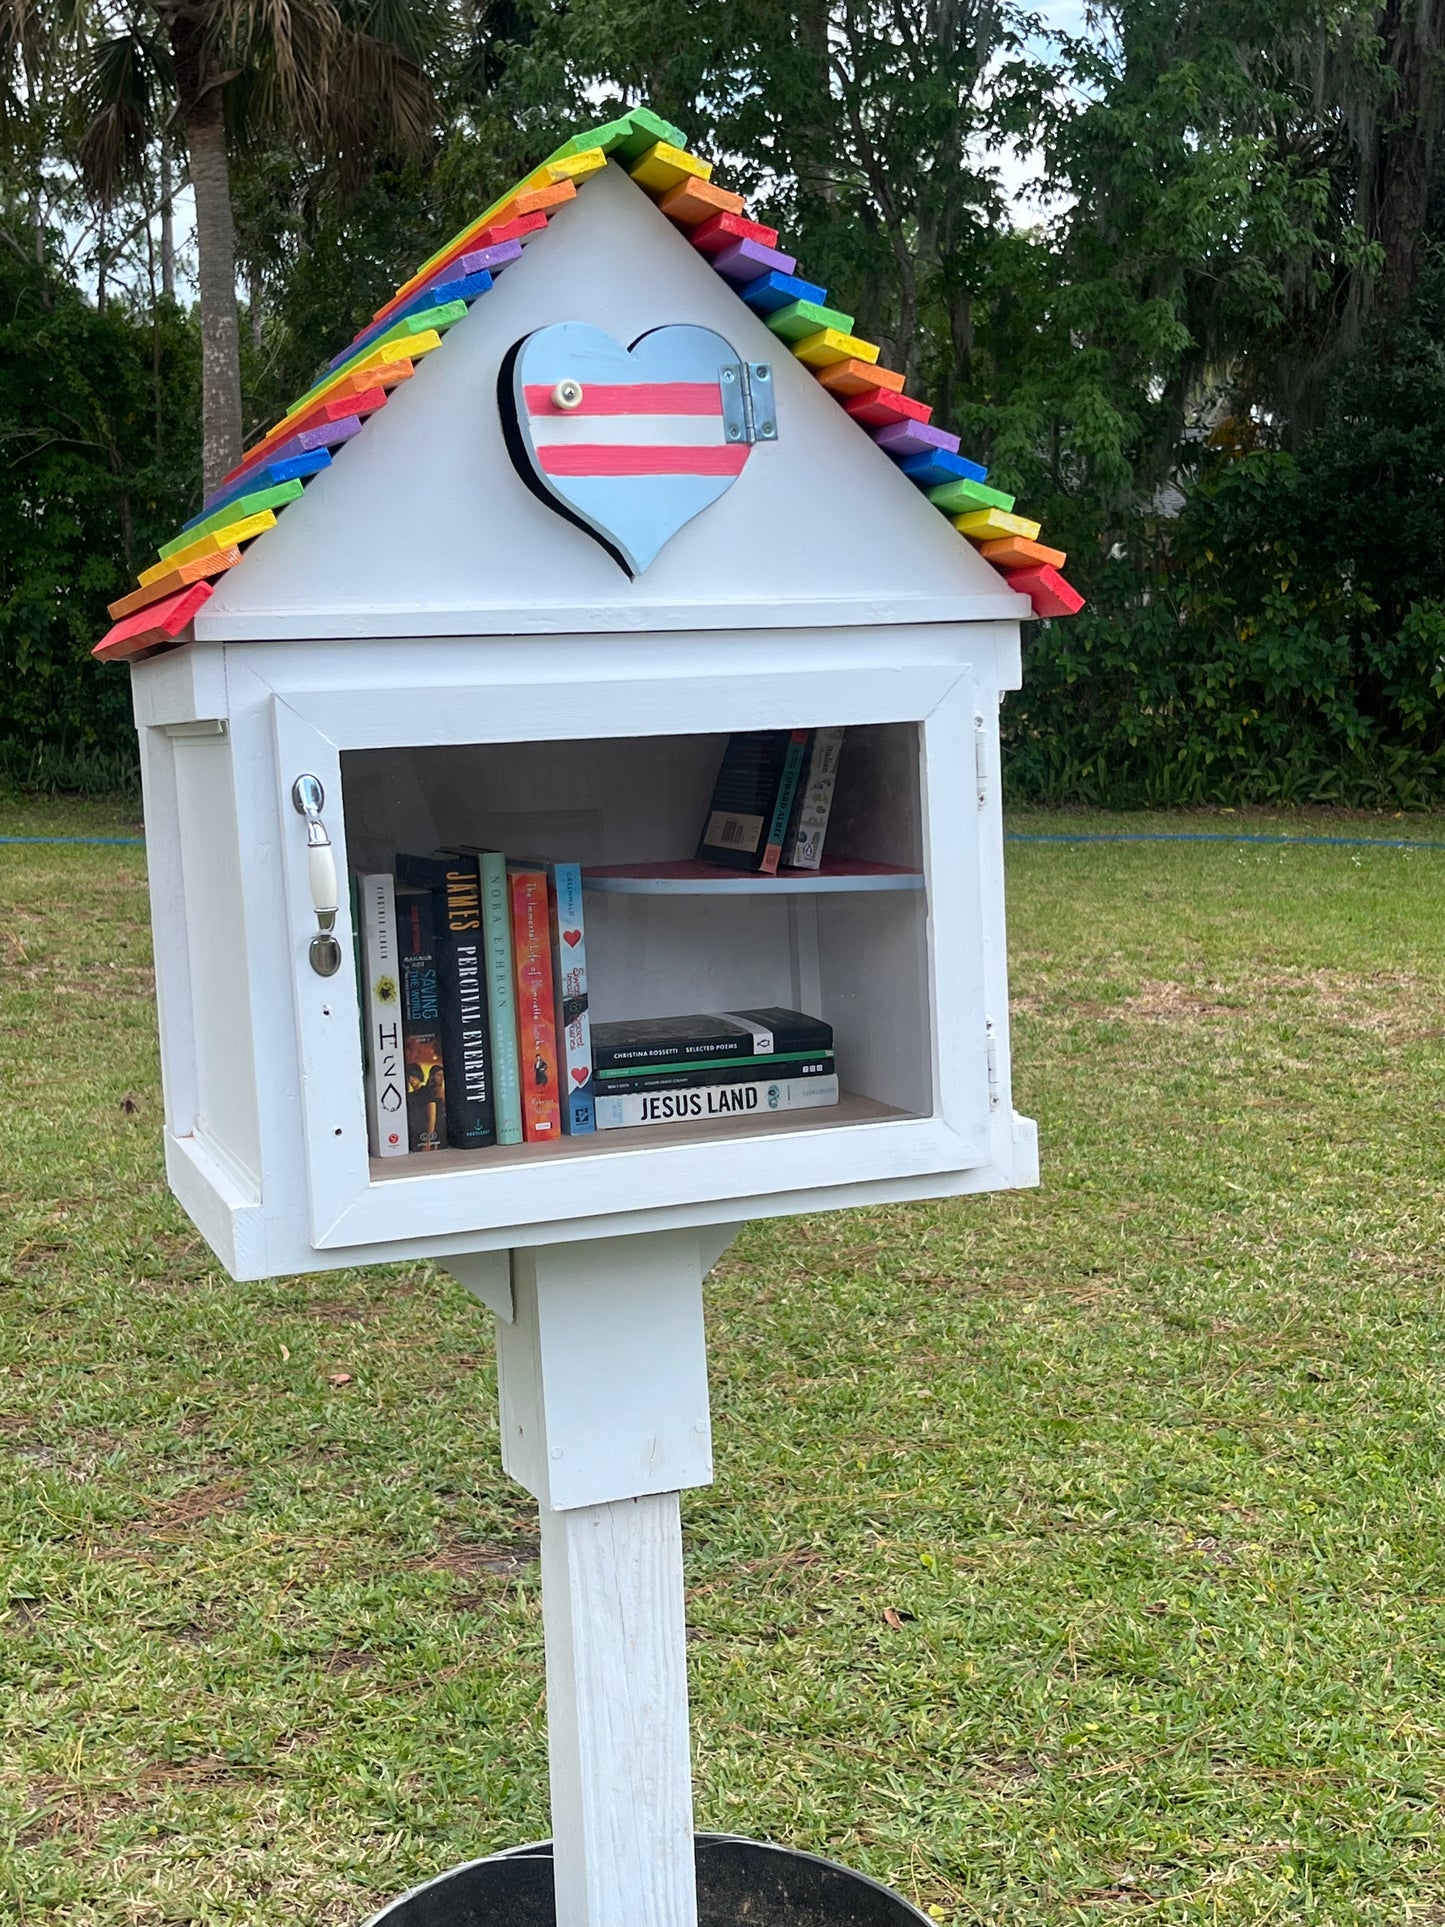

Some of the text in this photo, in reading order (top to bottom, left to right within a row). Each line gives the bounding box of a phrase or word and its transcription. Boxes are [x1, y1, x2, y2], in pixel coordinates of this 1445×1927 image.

[445, 871, 480, 931] JAMES
[526, 882, 537, 898] The
[566, 871, 575, 916] GREENWALD
[527, 901, 541, 940] Immortal
[490, 876, 507, 1009] NORA EPHRON
[529, 945, 542, 963] Life
[410, 971, 419, 987] THE
[457, 945, 481, 1024] PERCIVAL
[527, 966, 542, 976] of
[411, 989, 421, 1020] WORLD
[420, 969, 439, 1019] SAVING
[462, 1029, 486, 1102] EVERETT
[613, 1043, 738, 1059] CHRISTINA ROSSETTI SELECTED POEMS
[640, 1092, 702, 1121] JESUS
[707, 1086, 758, 1114] LAND
